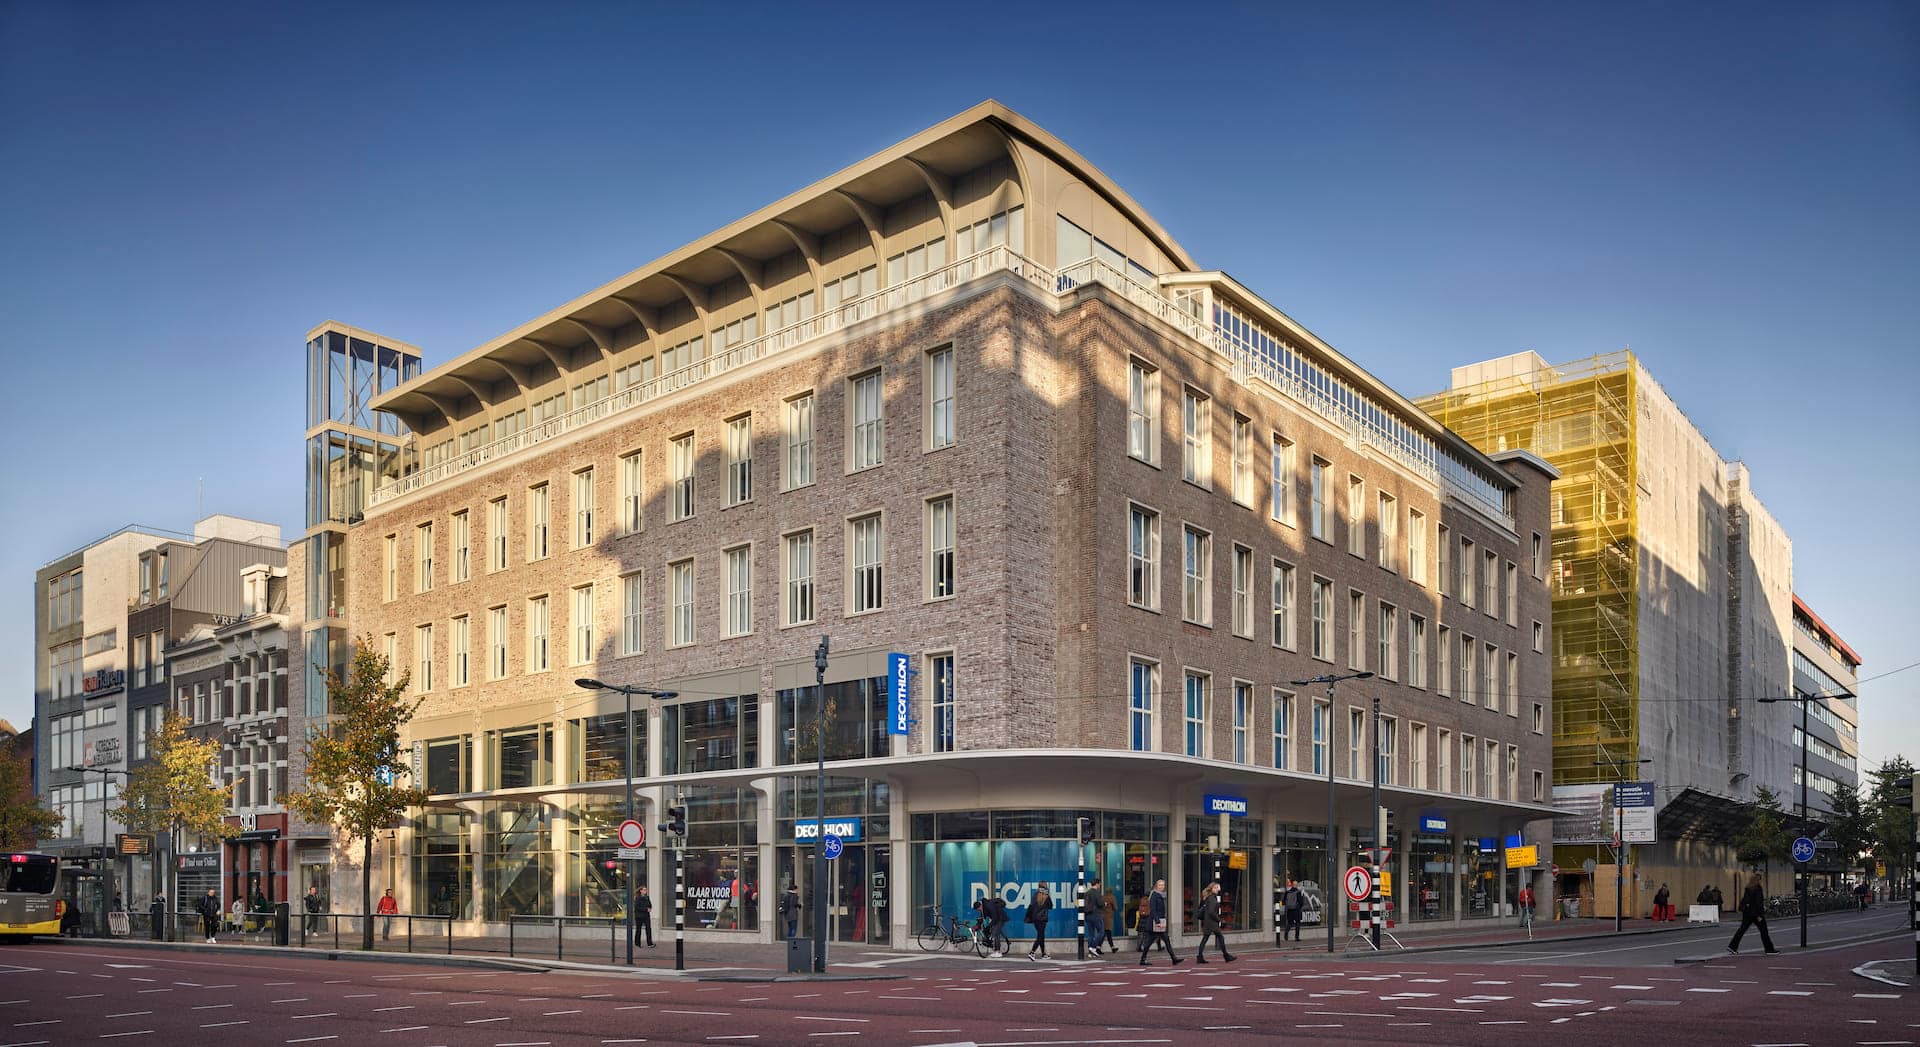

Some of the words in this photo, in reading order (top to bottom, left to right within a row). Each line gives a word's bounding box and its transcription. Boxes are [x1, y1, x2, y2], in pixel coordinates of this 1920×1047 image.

[898, 657, 907, 731] DECATHLON
[1212, 799, 1246, 812] DECATHLON
[795, 823, 853, 838] DECAHLON
[687, 887, 709, 898] KLAAR
[711, 887, 731, 898] VOOR
[872, 891, 883, 899] PIN
[696, 898, 705, 910] DE
[706, 898, 720, 910] KOU
[872, 900, 887, 908] ONLY
